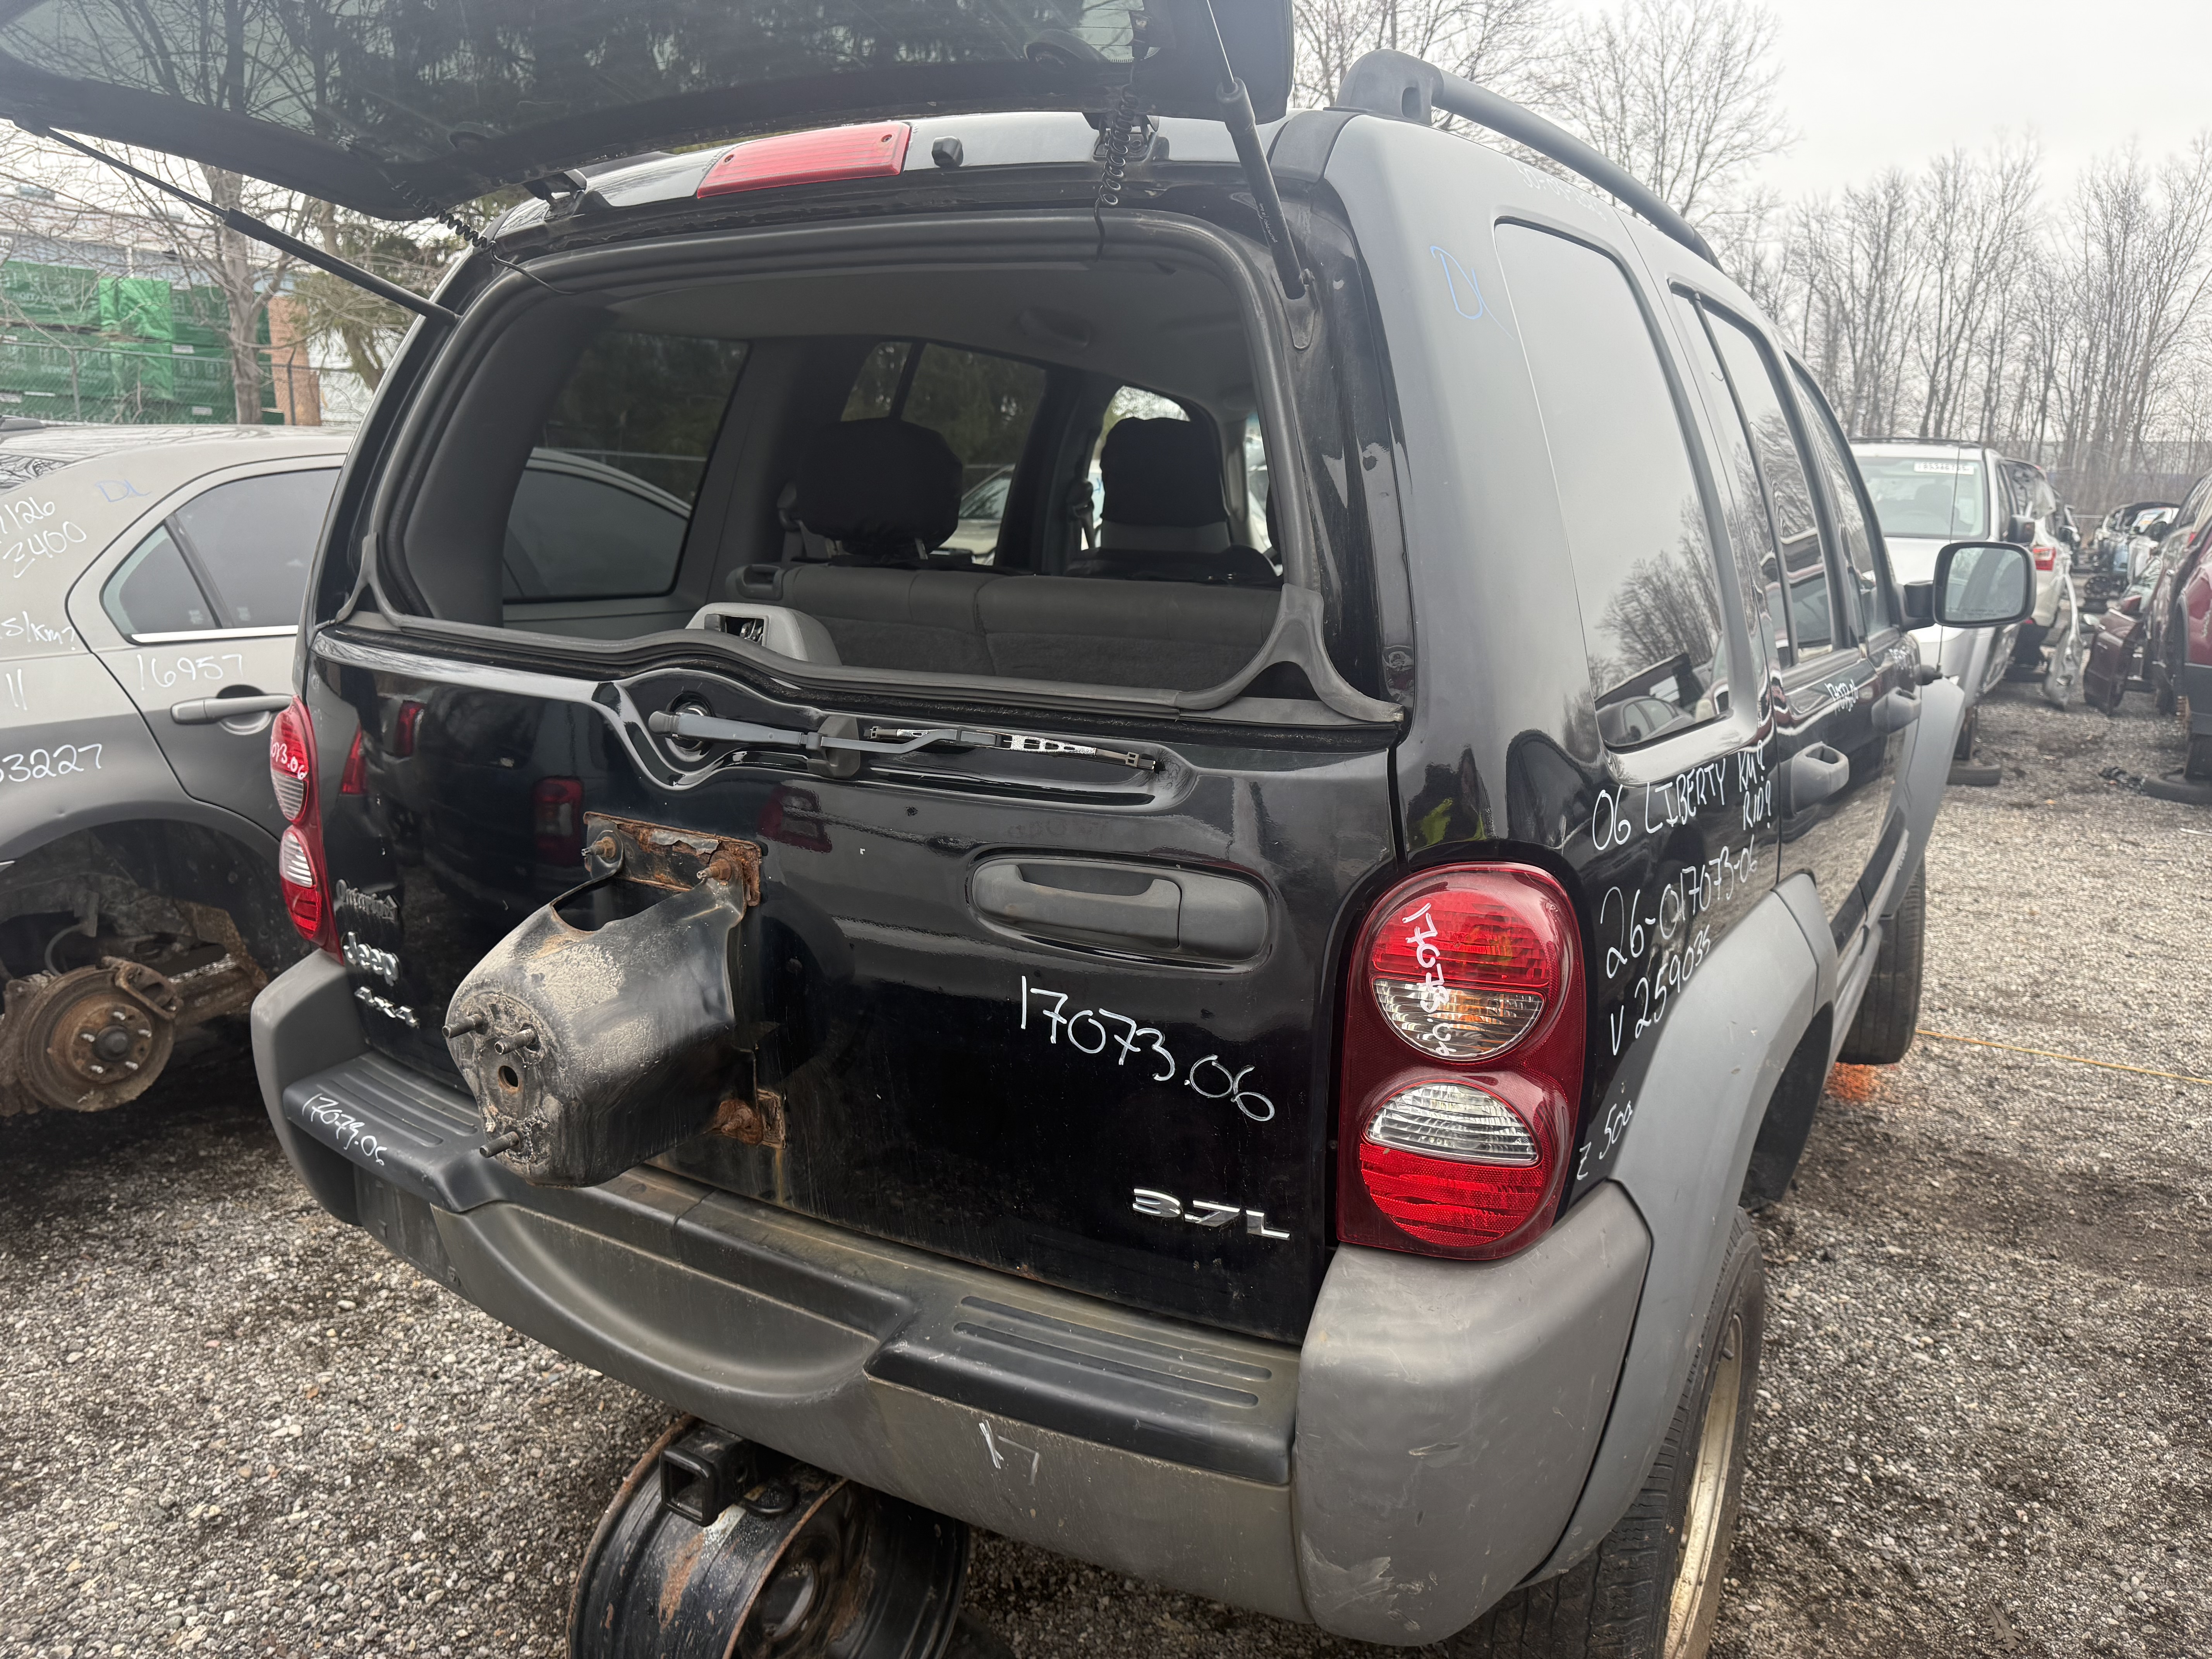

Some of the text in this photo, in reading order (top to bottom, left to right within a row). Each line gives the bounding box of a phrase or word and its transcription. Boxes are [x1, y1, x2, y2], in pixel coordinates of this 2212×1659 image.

[137, 654, 244, 690] 16957
[271, 737, 307, 780] 073.06
[1592, 784, 1631, 850] 06
[1645, 758, 1726, 834] LIBERTY
[343, 931, 400, 987] Jeep
[1021, 975, 1275, 1121] 17073.06
[1132, 1188, 1290, 1240] 3.7L
